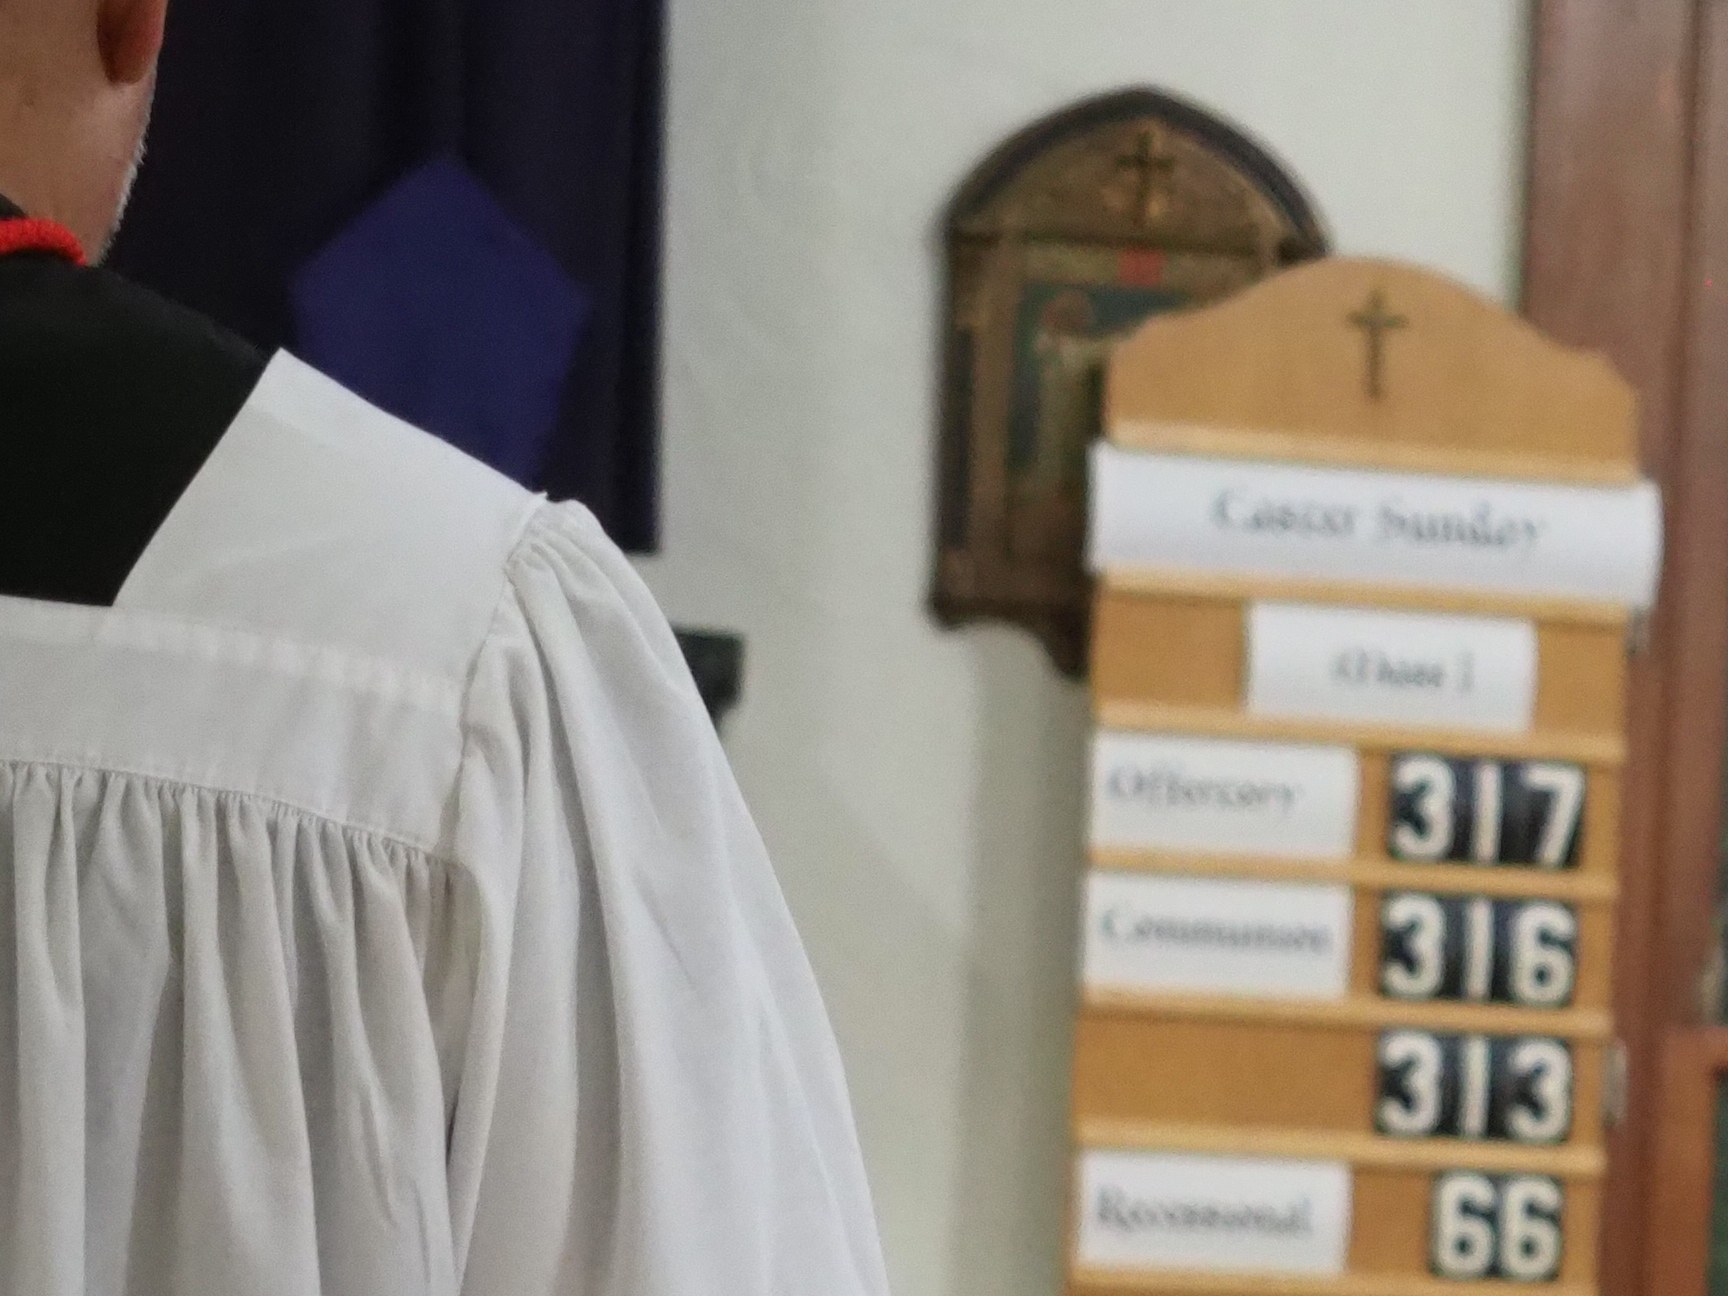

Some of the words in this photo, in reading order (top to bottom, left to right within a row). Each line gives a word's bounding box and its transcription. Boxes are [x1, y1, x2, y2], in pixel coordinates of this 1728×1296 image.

[1392, 755, 1587, 867] 317
[1380, 895, 1577, 1009] 316
[1378, 1030, 1574, 1142] 313
[1430, 1174, 1562, 1281] 66
